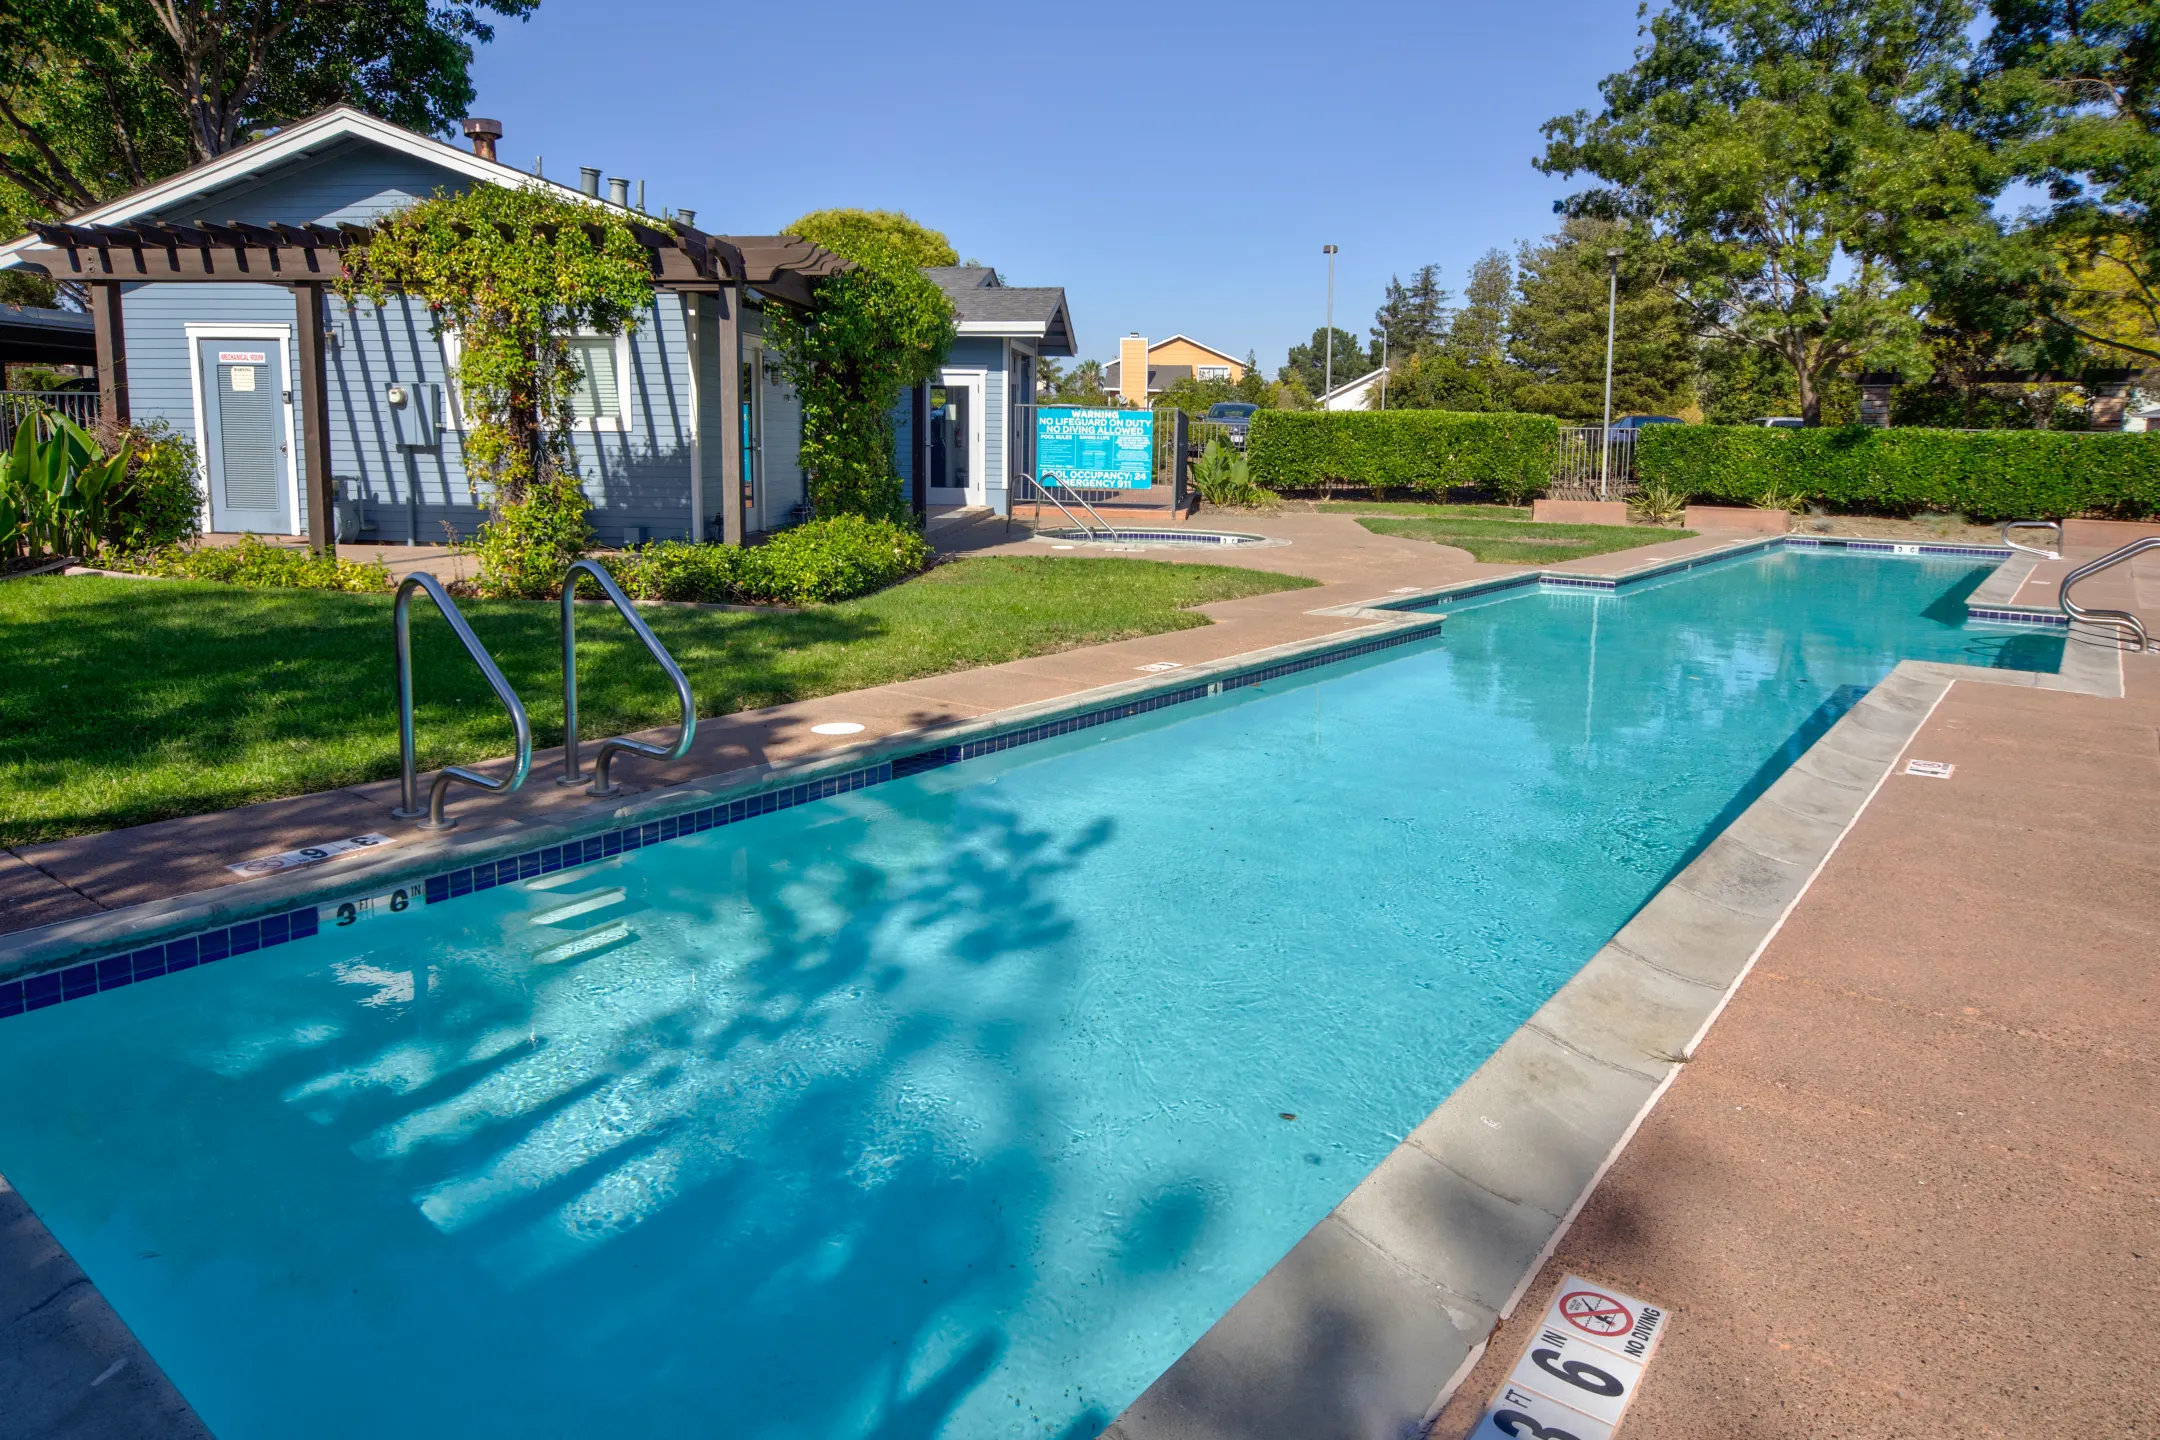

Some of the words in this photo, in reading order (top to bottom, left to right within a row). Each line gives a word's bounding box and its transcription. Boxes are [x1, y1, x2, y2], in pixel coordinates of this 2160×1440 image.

[220, 353, 249, 361] MECHANICAL
[1071, 410, 1119, 419] WARNING
[1039, 417, 1053, 425] NO
[1055, 418, 1107, 427] LIFEGUARD
[1109, 419, 1123, 427] ON
[1125, 419, 1152, 427] DUTY
[1046, 425, 1060, 433] NO
[1063, 426, 1095, 434] DIVING
[1097, 426, 1144, 435] ALLOWED
[1070, 470, 1132, 480] OCCUPANCY:
[1134, 472, 1146, 480] 24
[1117, 480, 1132, 488] 911
[300, 848, 328, 858] 6
[336, 902, 357, 926] 3
[360, 898, 369, 910] FT
[390, 888, 409, 912] 6
[411, 884, 421, 897] IN
[1624, 1339, 1646, 1358] NO
[1636, 1307, 1661, 1342] DIVING
[1541, 1330, 1568, 1348] IN
[1531, 1348, 1624, 1397] 6
[1504, 1388, 1532, 1408] FT
[1493, 1409, 1582, 1440] 3
